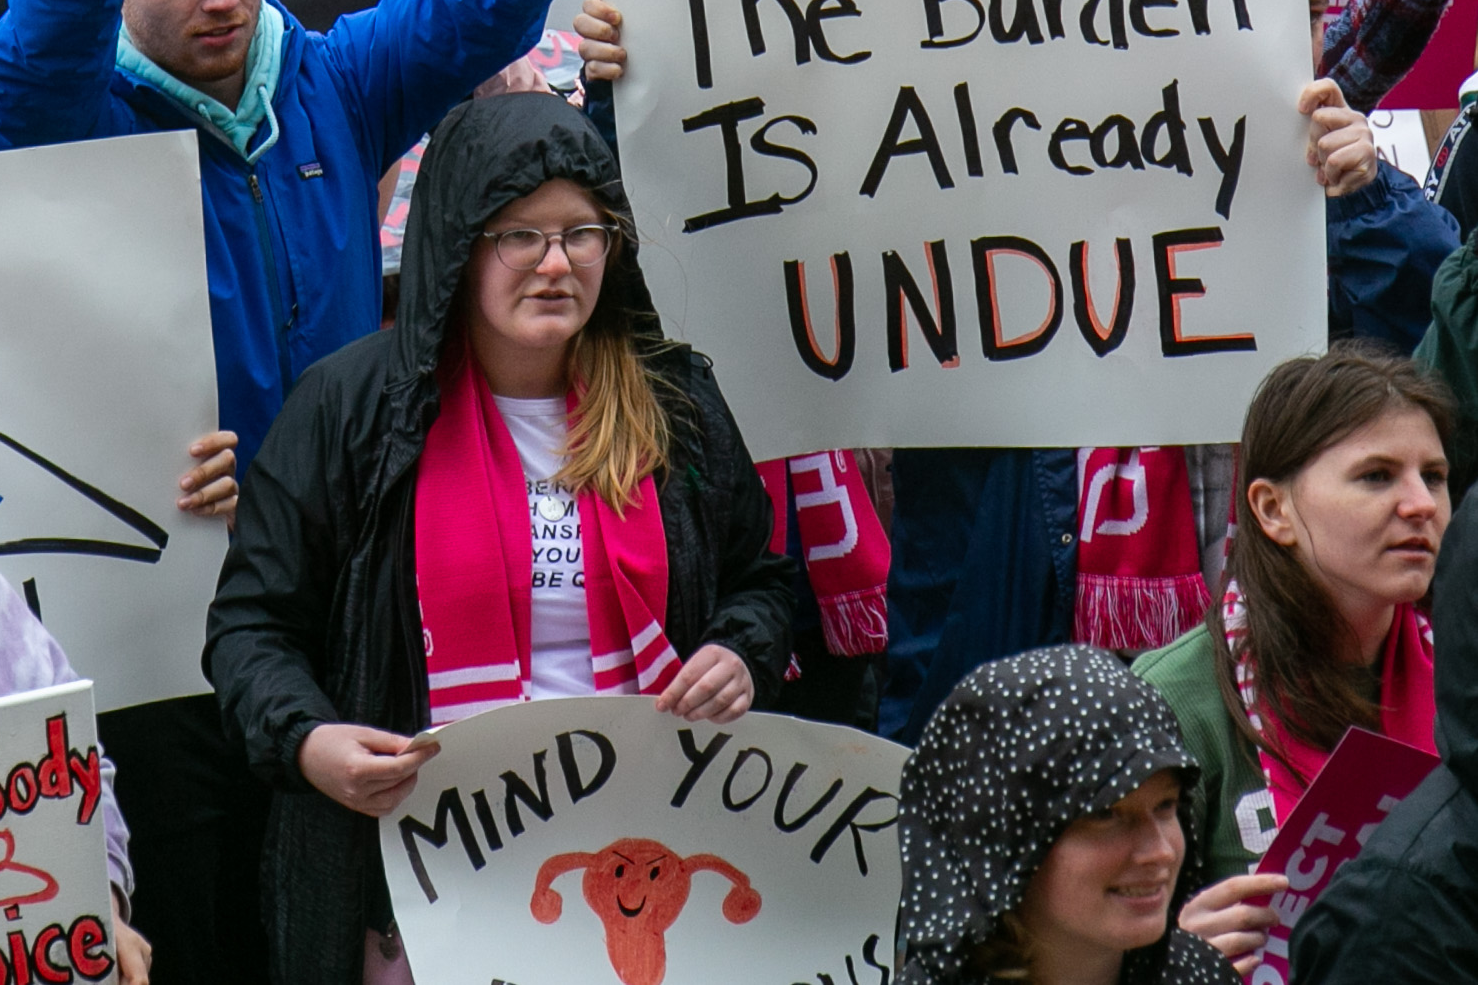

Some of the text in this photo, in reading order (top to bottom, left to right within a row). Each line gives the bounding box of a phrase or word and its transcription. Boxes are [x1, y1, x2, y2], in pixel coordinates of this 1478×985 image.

[681, 96, 819, 235] Is
[858, 78, 1247, 221] Already
[782, 225, 1258, 383] UNDUE
[531, 571, 564, 589] BE
[532, 547, 581, 564] YOU
[396, 727, 901, 905] MIND YOUR
